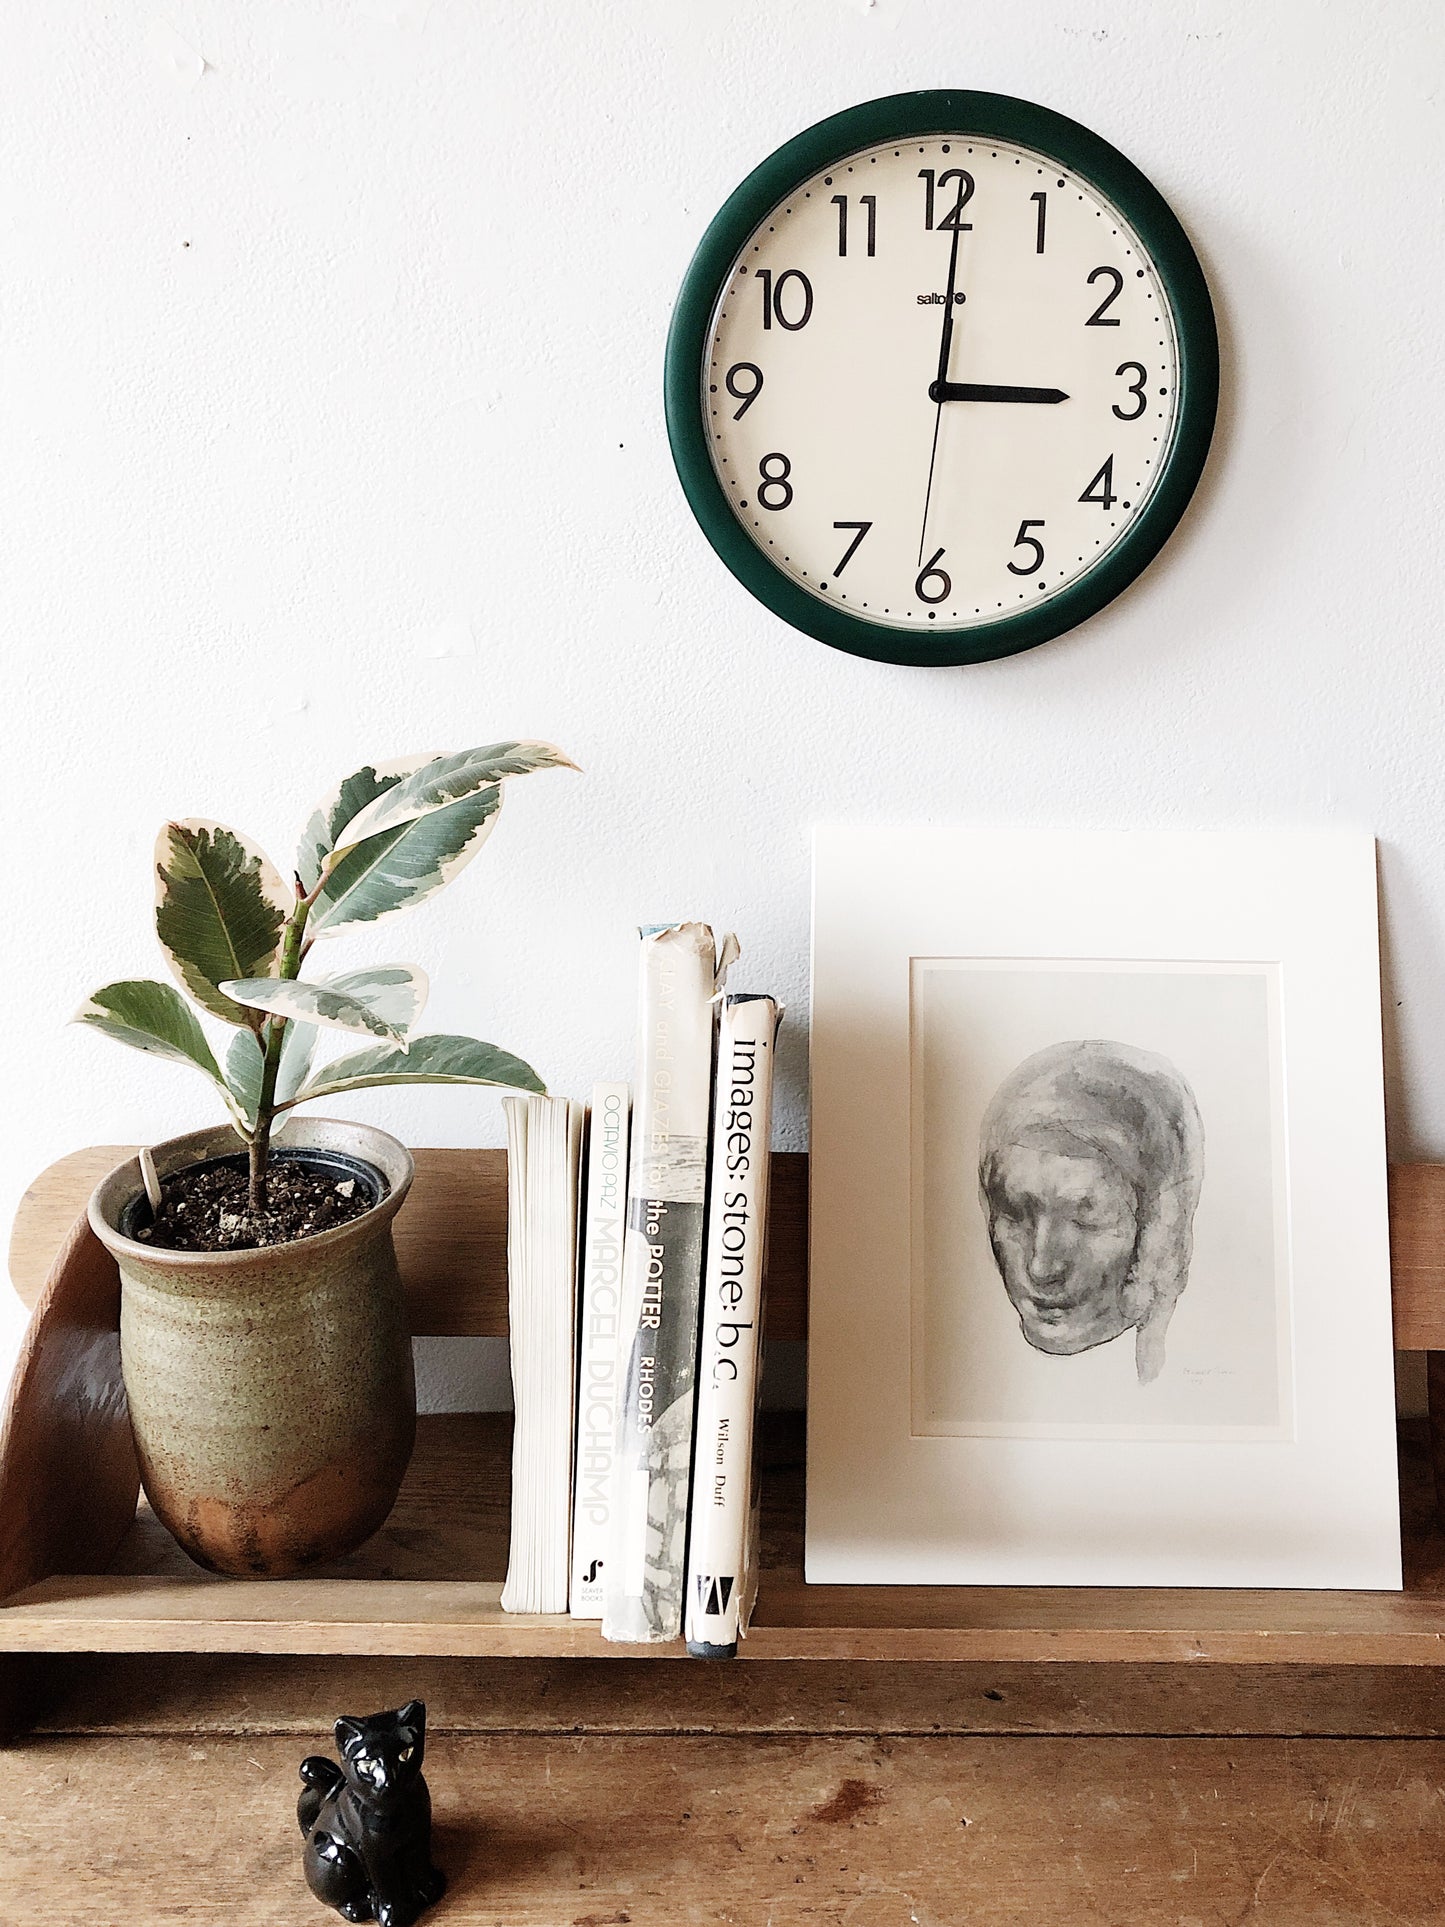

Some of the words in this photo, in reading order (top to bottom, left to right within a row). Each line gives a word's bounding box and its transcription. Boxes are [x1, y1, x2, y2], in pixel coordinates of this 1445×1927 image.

[831, 195, 877, 258] 11
[918, 169, 974, 231] 12
[1029, 191, 1047, 254] 1
[755, 269, 814, 331] 10
[1085, 266, 1123, 327] 2
[726, 362, 764, 422] 9
[1112, 362, 1148, 421] 3
[757, 453, 793, 511] 8
[1078, 453, 1118, 511] 4
[833, 522, 873, 578] 7
[915, 548, 952, 605] 6
[1007, 520, 1046, 576] 5
[655, 1021, 675, 1060] and
[601, 1094, 621, 1170] OCTAVIO
[652, 1070, 673, 1155] GLAZES
[723, 1039, 768, 1181] images:
[599, 1173, 618, 1209] PAZ
[646, 1200, 669, 1236] the
[719, 1192, 751, 1312] stone:
[589, 1217, 619, 1349] MARCEL
[641, 1244, 665, 1330] POTTER
[712, 1321, 754, 1390] b.c.
[638, 1356, 655, 1434] RHODES
[582, 1360, 615, 1526] DUCHAMP
[715, 1418, 730, 1465] Wilson
[713, 1475, 727, 1508] Duff
